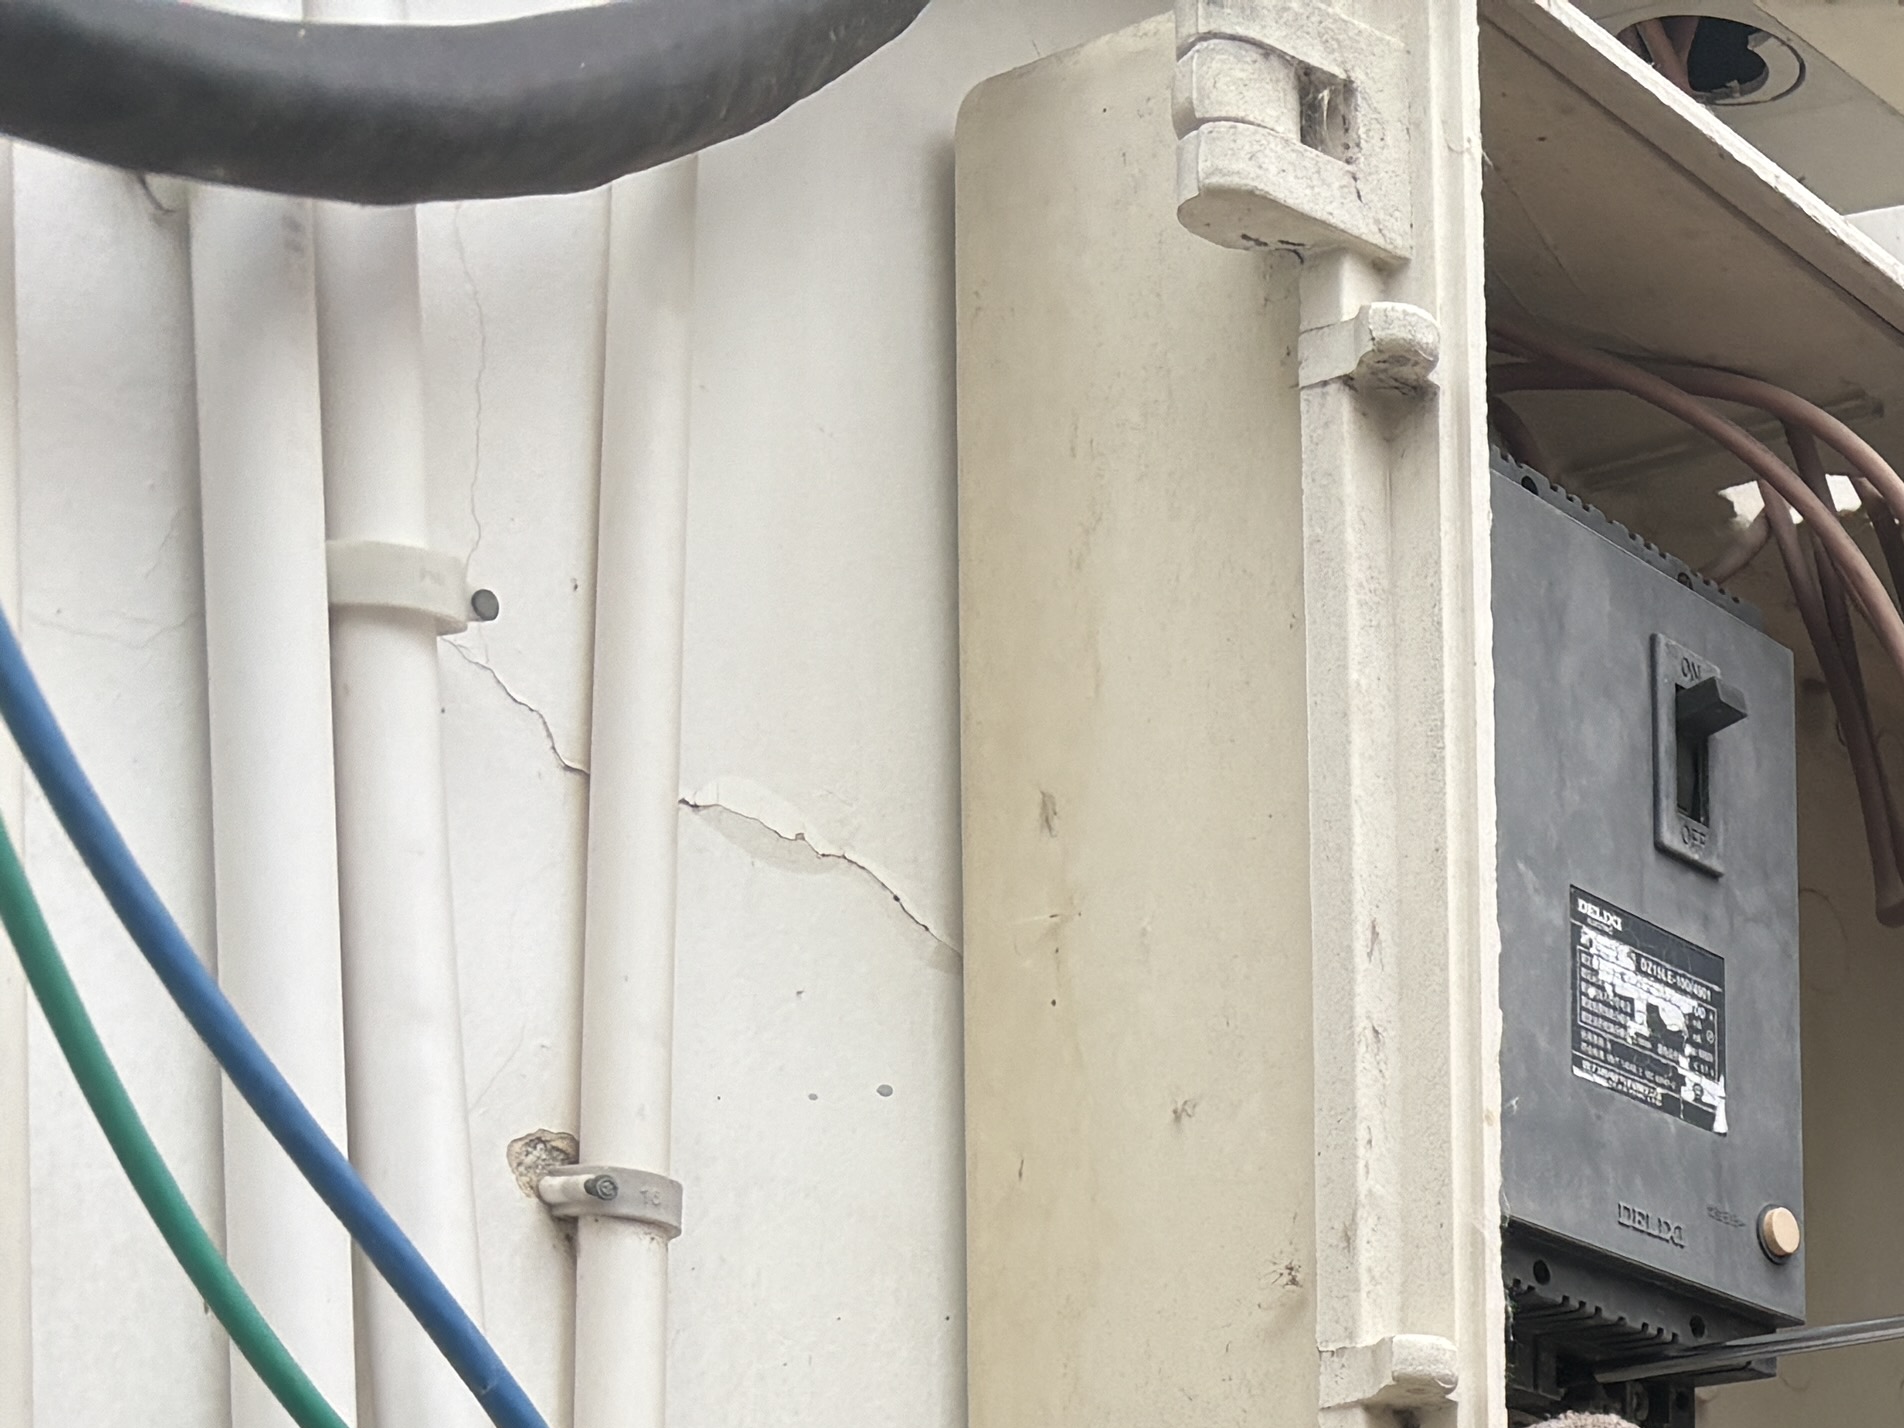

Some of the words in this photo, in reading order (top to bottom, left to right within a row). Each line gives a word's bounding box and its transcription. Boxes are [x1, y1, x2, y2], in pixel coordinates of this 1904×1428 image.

[1680, 656, 1702, 682] ON
[1681, 825, 1706, 848] OFF
[1577, 897, 1623, 931] DELIXI
[1617, 1202, 1686, 1250] DELIXI
